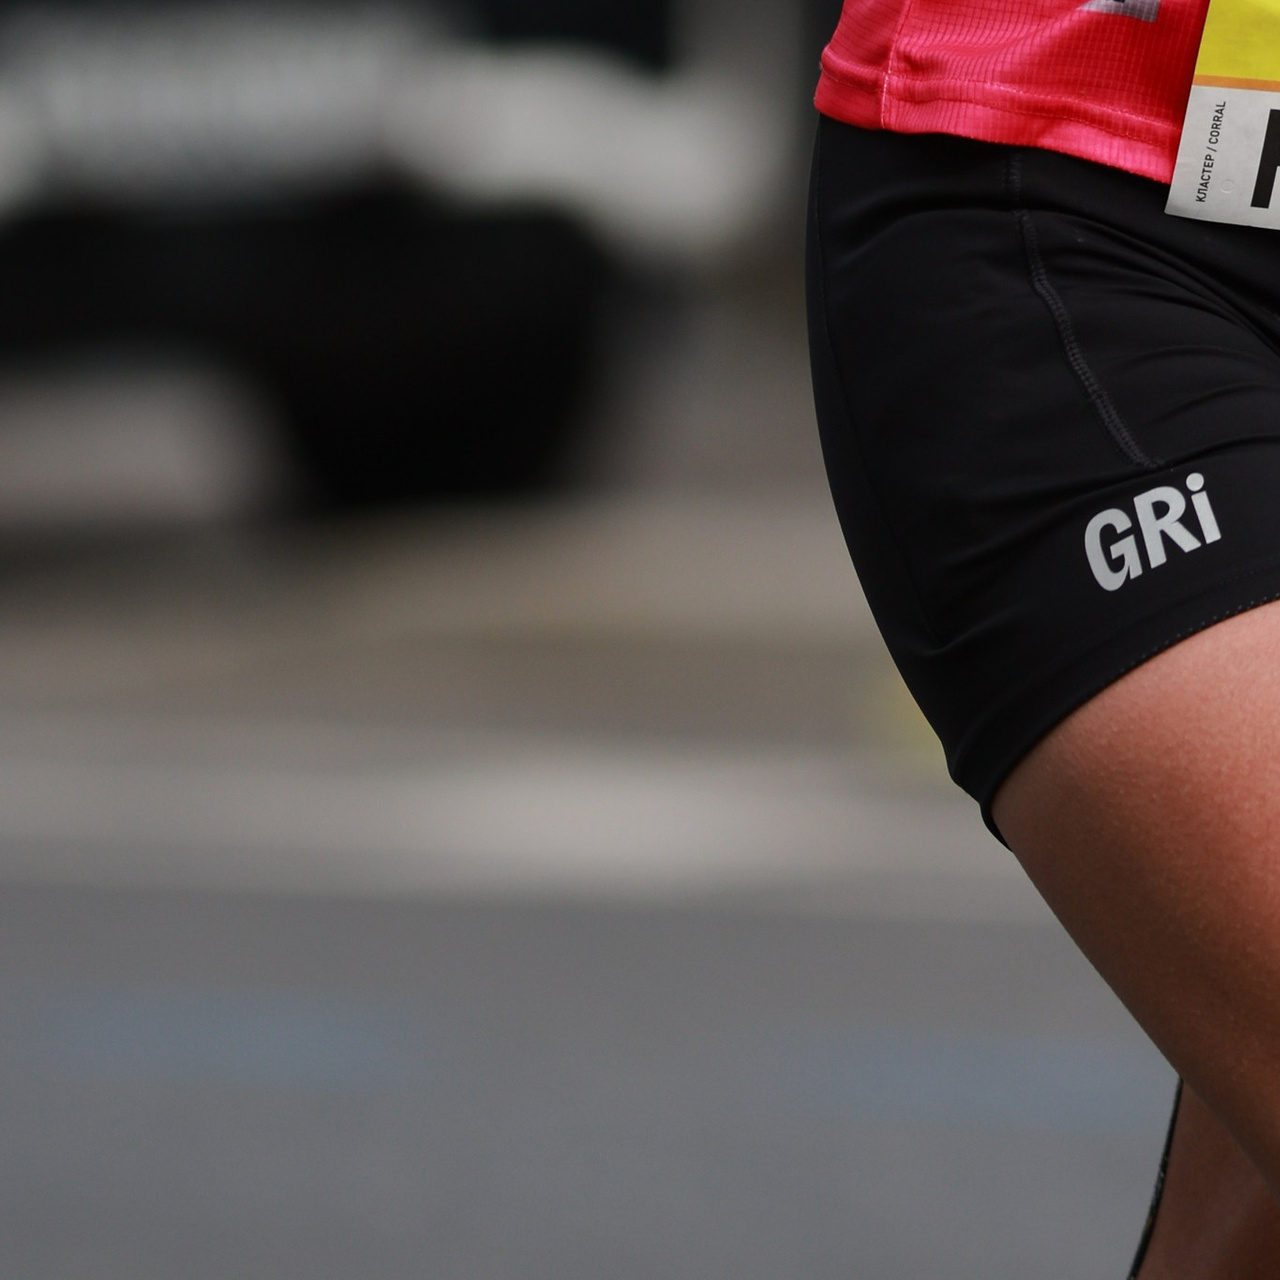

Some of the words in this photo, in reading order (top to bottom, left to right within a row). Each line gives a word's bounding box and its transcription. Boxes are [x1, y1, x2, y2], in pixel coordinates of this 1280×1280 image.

[1195, 153, 1215, 203] КЛАСТЕР
[1208, 101, 1227, 145] CORRAL
[1084, 472, 1222, 592] GRi
